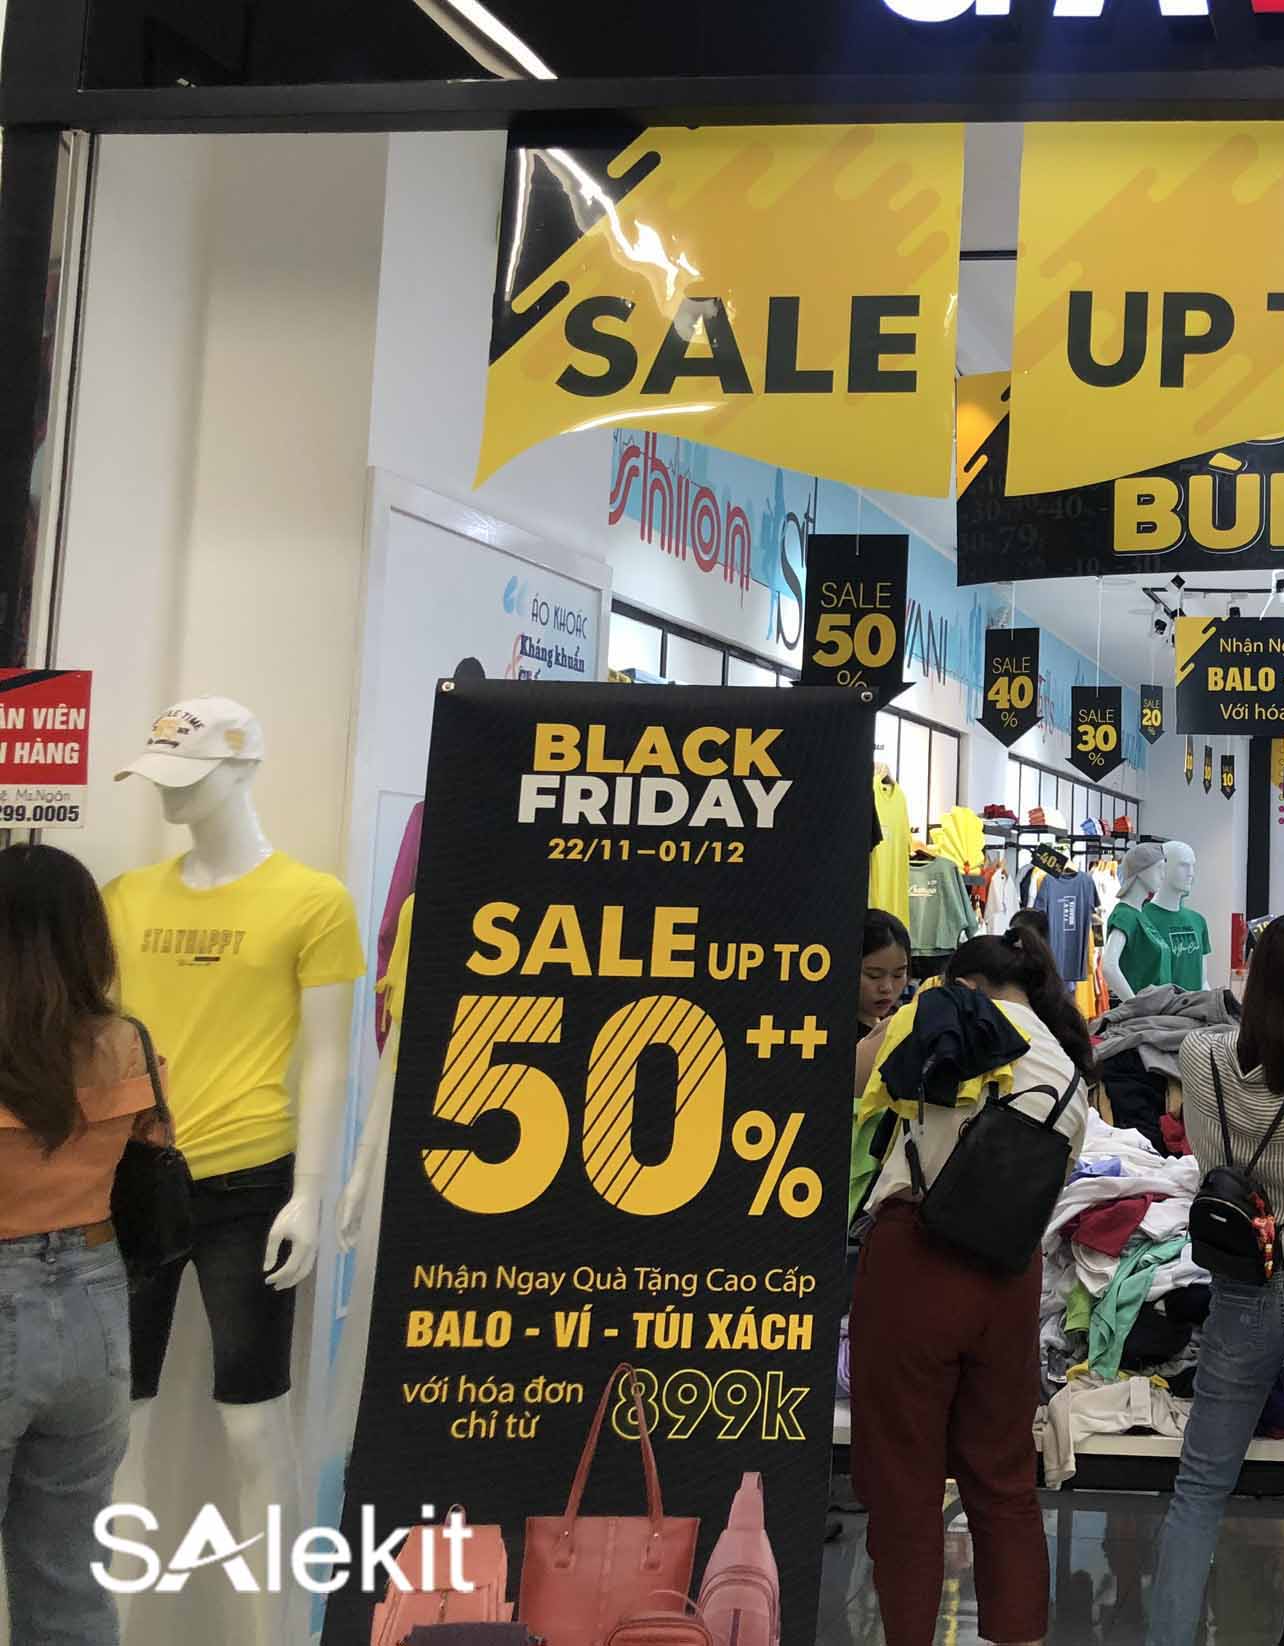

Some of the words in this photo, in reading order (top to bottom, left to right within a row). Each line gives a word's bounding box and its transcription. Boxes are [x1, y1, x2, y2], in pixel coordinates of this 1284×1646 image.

[555, 294, 920, 397] SALE
[1067, 290, 1235, 388] UP
[820, 581, 892, 609] SALE
[812, 613, 897, 668] 50
[1219, 637, 1264, 656] Nhận
[992, 656, 1031, 674] SALE
[1207, 666, 1276, 692] BALO
[987, 675, 1035, 710] 40
[32, 703, 86, 730] VIÊN
[1000, 711, 1018, 728] %
[1078, 709, 1115, 724] SALE
[1142, 708, 1162, 727] 20
[1219, 703, 1249, 721] Với
[13, 737, 80, 765] HÀNG
[532, 722, 784, 778] BLACK
[1075, 723, 1118, 753] 30
[0, 804, 80, 822] 99.0005
[517, 774, 793, 829] FRIDAY
[465, 901, 700, 978] SALE
[708, 943, 765, 981] UP
[772, 943, 832, 982] TO
[421, 994, 728, 1216] 50
[414, 1264, 488, 1295] Nhận
[495, 1265, 565, 1296] Ngay
[572, 1264, 627, 1293] Quà
[635, 1266, 698, 1298] Tặng
[706, 1268, 758, 1292] Cao
[764, 1264, 817, 1298] Cấp
[405, 1309, 513, 1349] BALO
[554, 1304, 592, 1348] VÍ
[632, 1305, 695, 1350] TÚI
[704, 1305, 814, 1351] XÁCH
[403, 1375, 450, 1405] với
[457, 1374, 515, 1404] hóa
[523, 1374, 584, 1404] đơn
[611, 1369, 811, 1441] 899k
[449, 1409, 500, 1440] chỉ
[504, 1412, 540, 1440] từ
